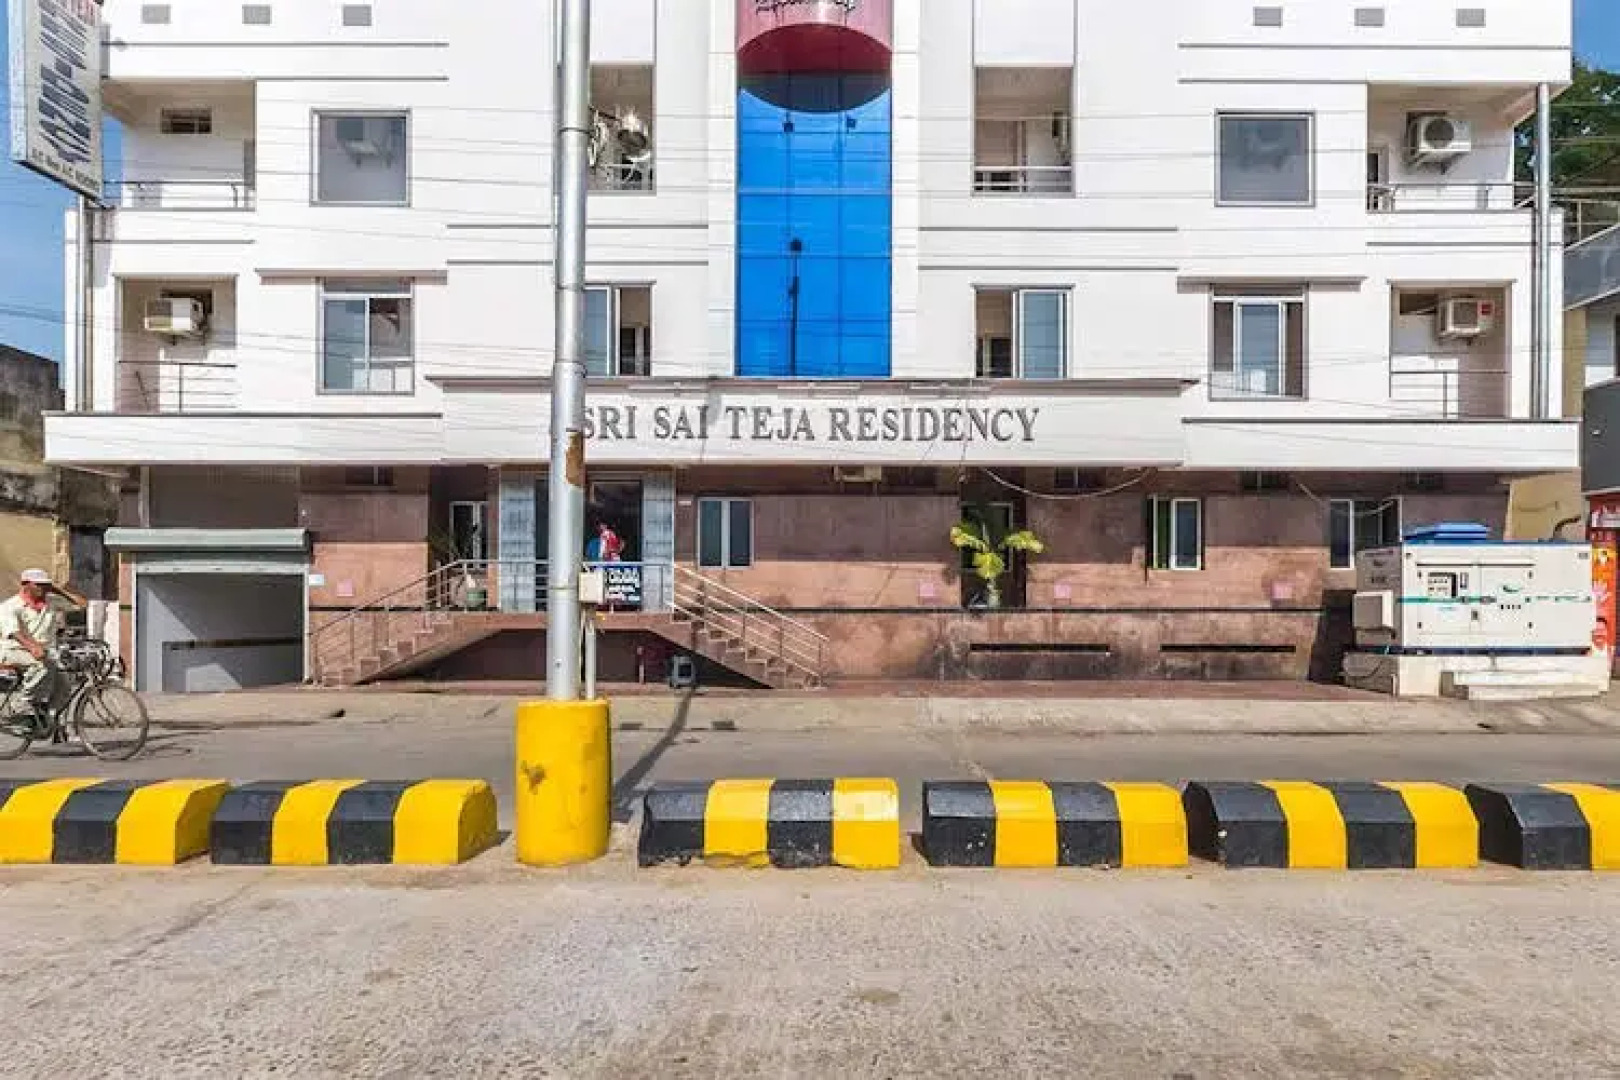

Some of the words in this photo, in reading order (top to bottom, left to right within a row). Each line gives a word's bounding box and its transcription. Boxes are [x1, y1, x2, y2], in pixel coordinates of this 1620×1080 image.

[583, 406, 637, 439] SRI
[654, 406, 709, 439] SAI
[725, 406, 815, 441] TEJA
[828, 407, 1040, 442] RESIDENCY
